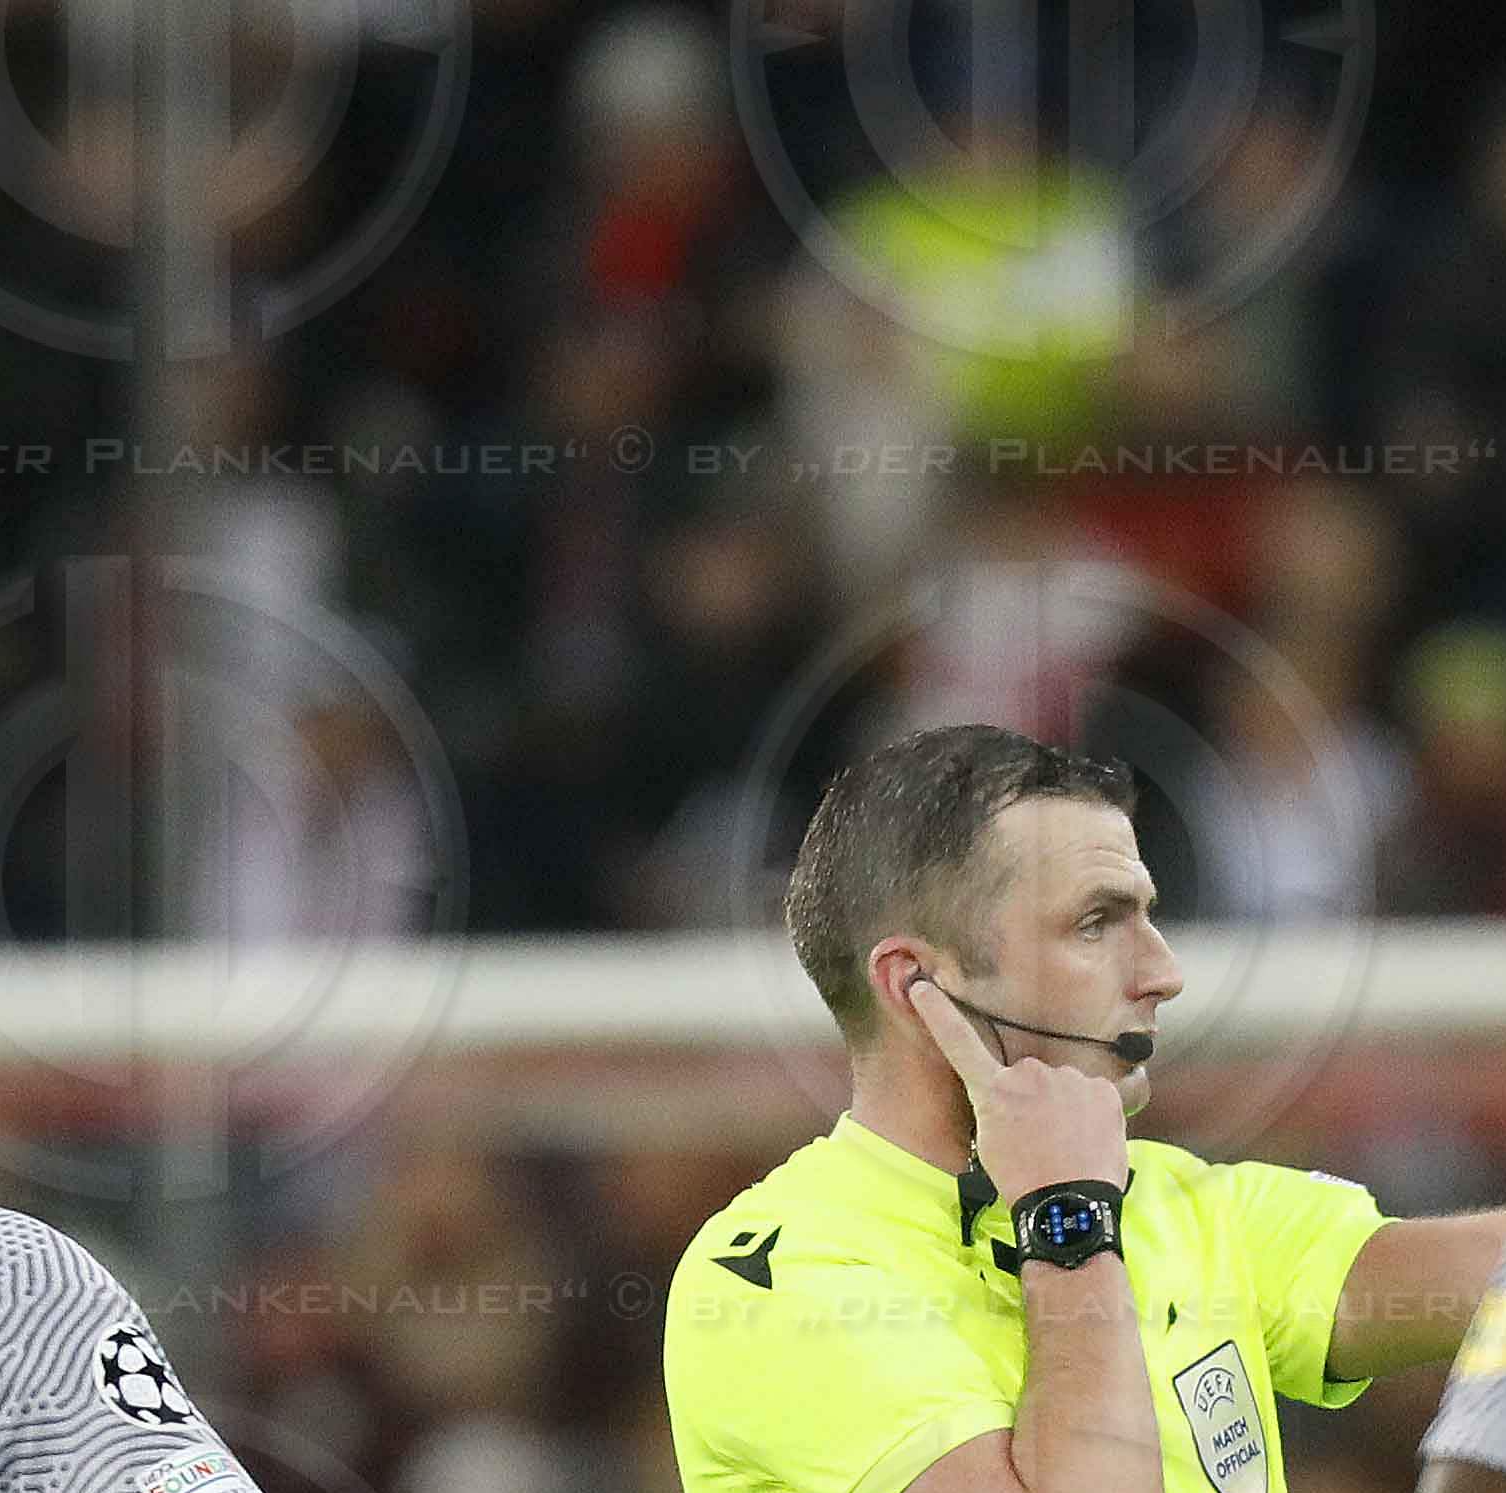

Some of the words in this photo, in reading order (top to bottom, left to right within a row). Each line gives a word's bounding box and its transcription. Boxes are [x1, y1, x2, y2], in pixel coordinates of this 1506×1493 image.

[1198, 1374, 1234, 1413] UEFA
[1212, 1415, 1250, 1454] MATCH
[1215, 1440, 1262, 1480] OFFICIAL
